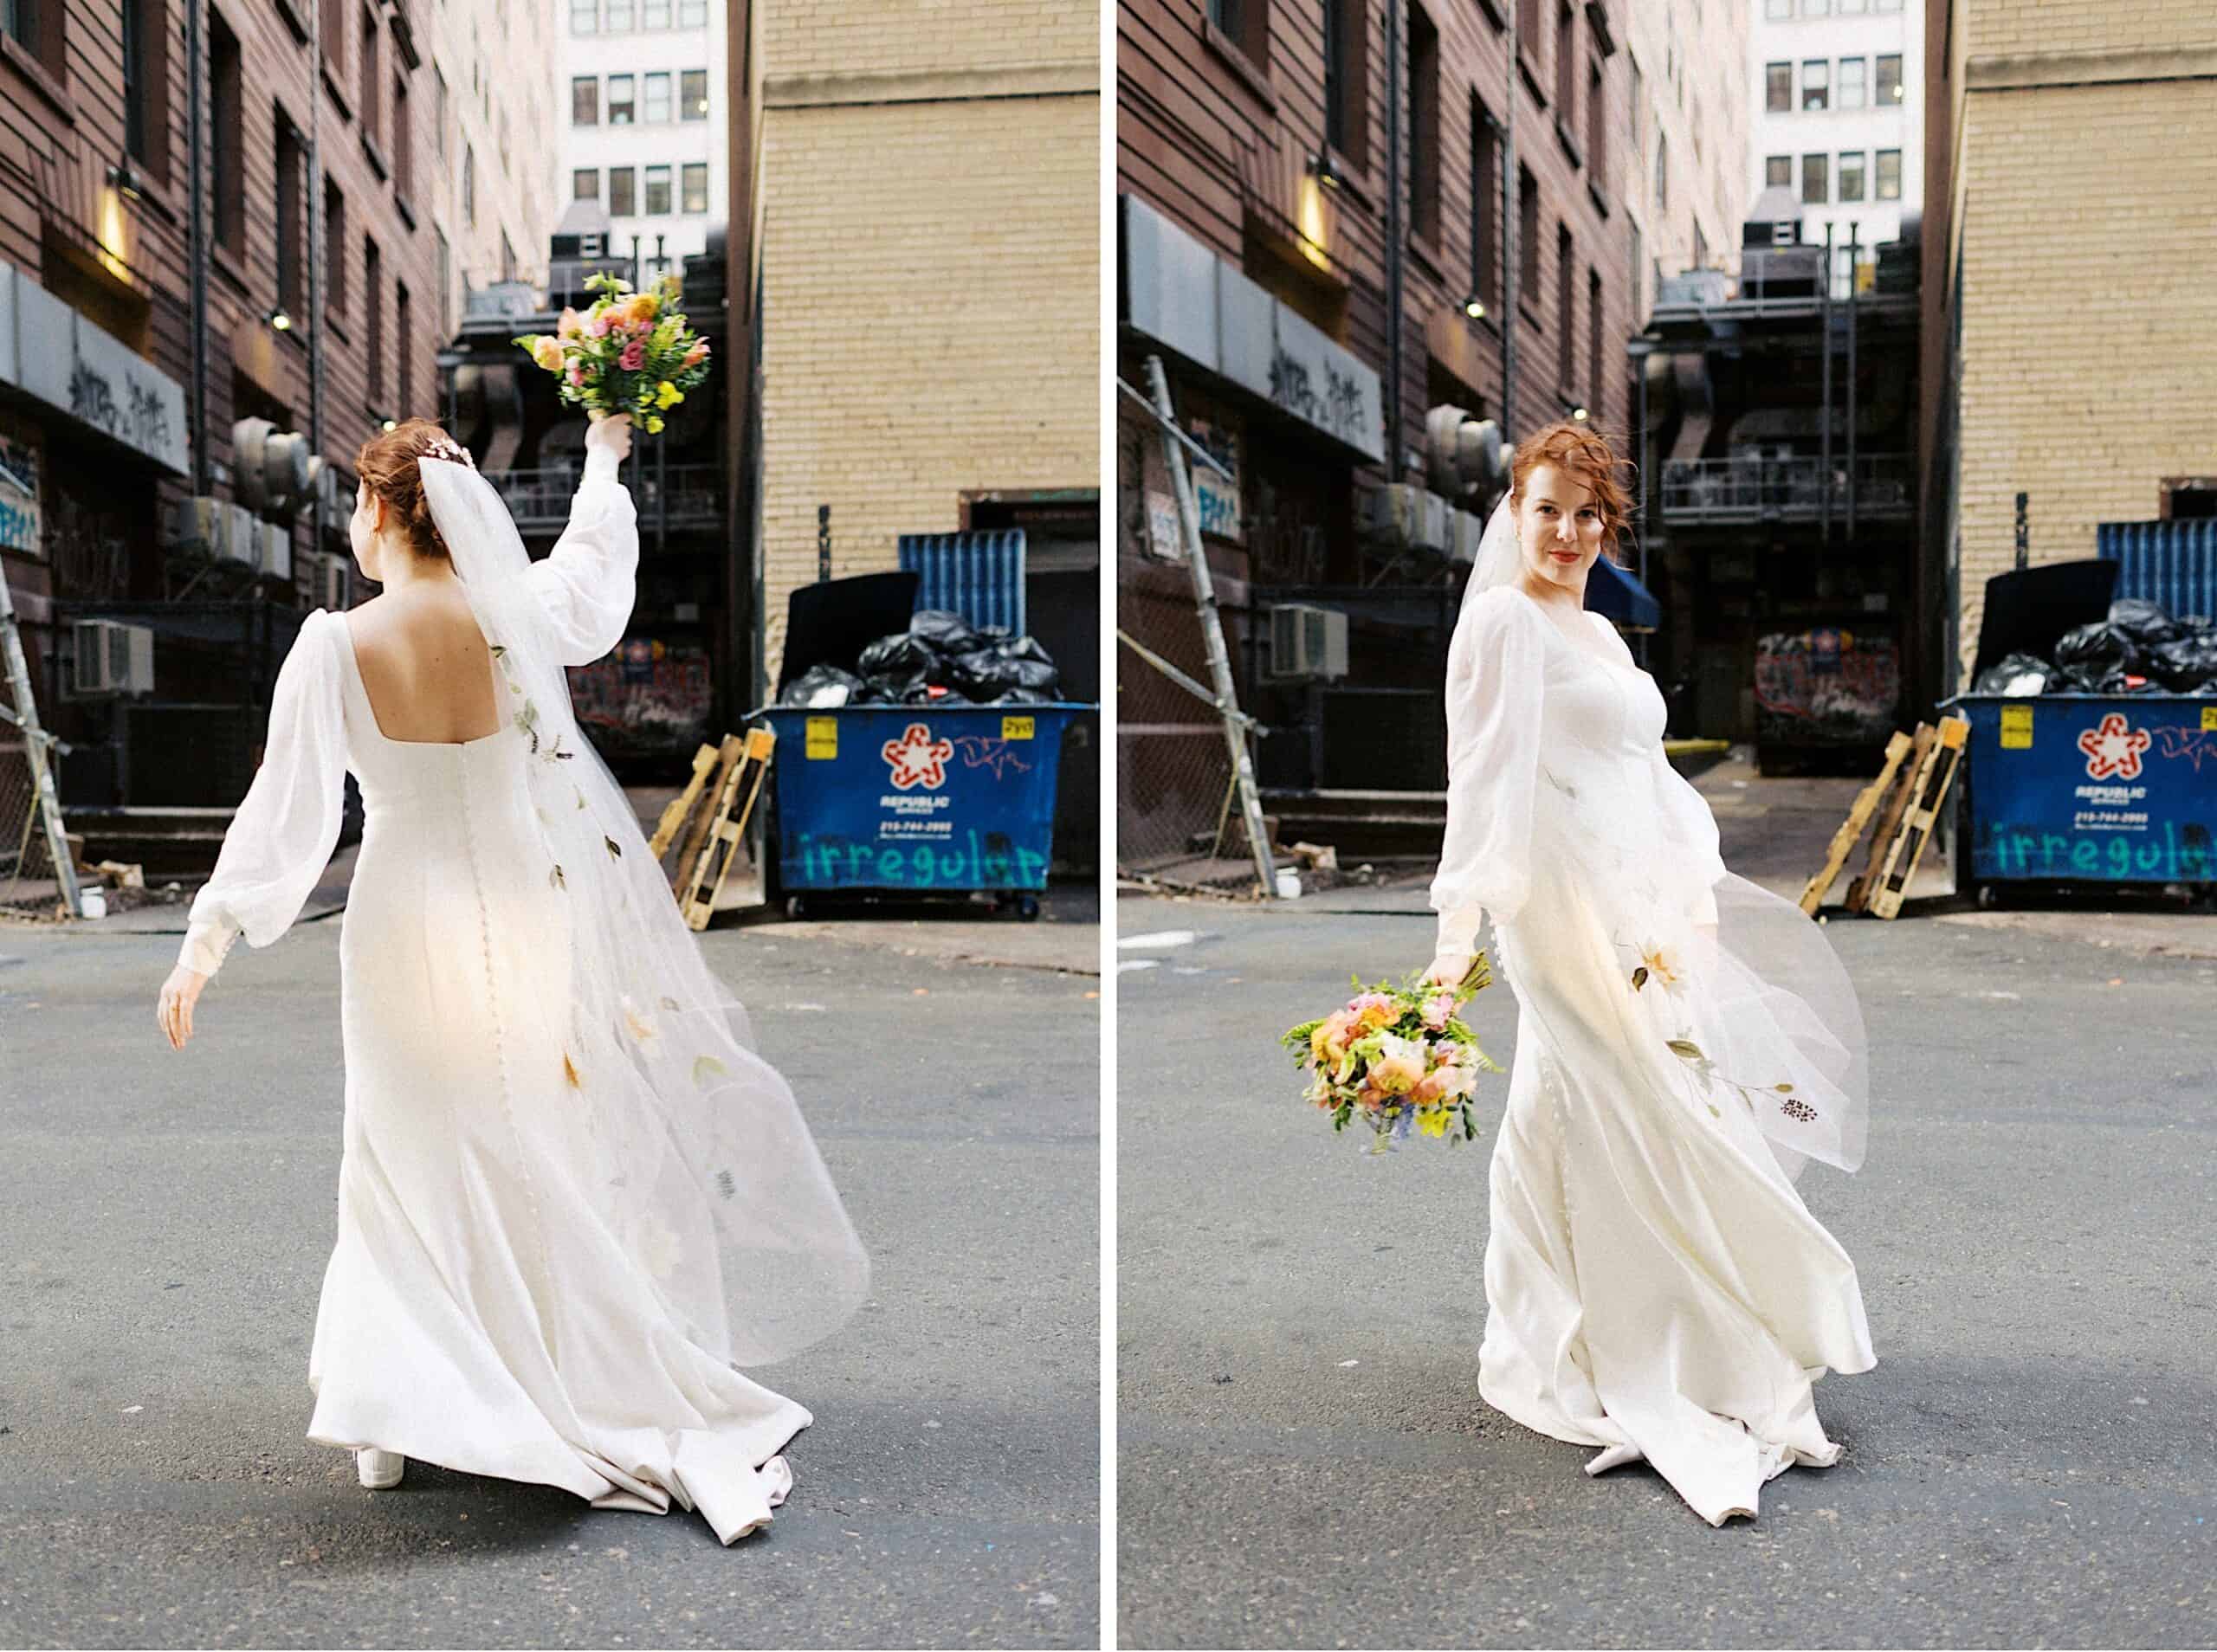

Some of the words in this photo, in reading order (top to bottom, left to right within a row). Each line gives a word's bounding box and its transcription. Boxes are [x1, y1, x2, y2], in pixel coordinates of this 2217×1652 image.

[2075, 786, 2146, 799] REPUBLIC
[880, 796, 950, 808] REPUBLIC
[1993, 821, 2217, 880] irregula
